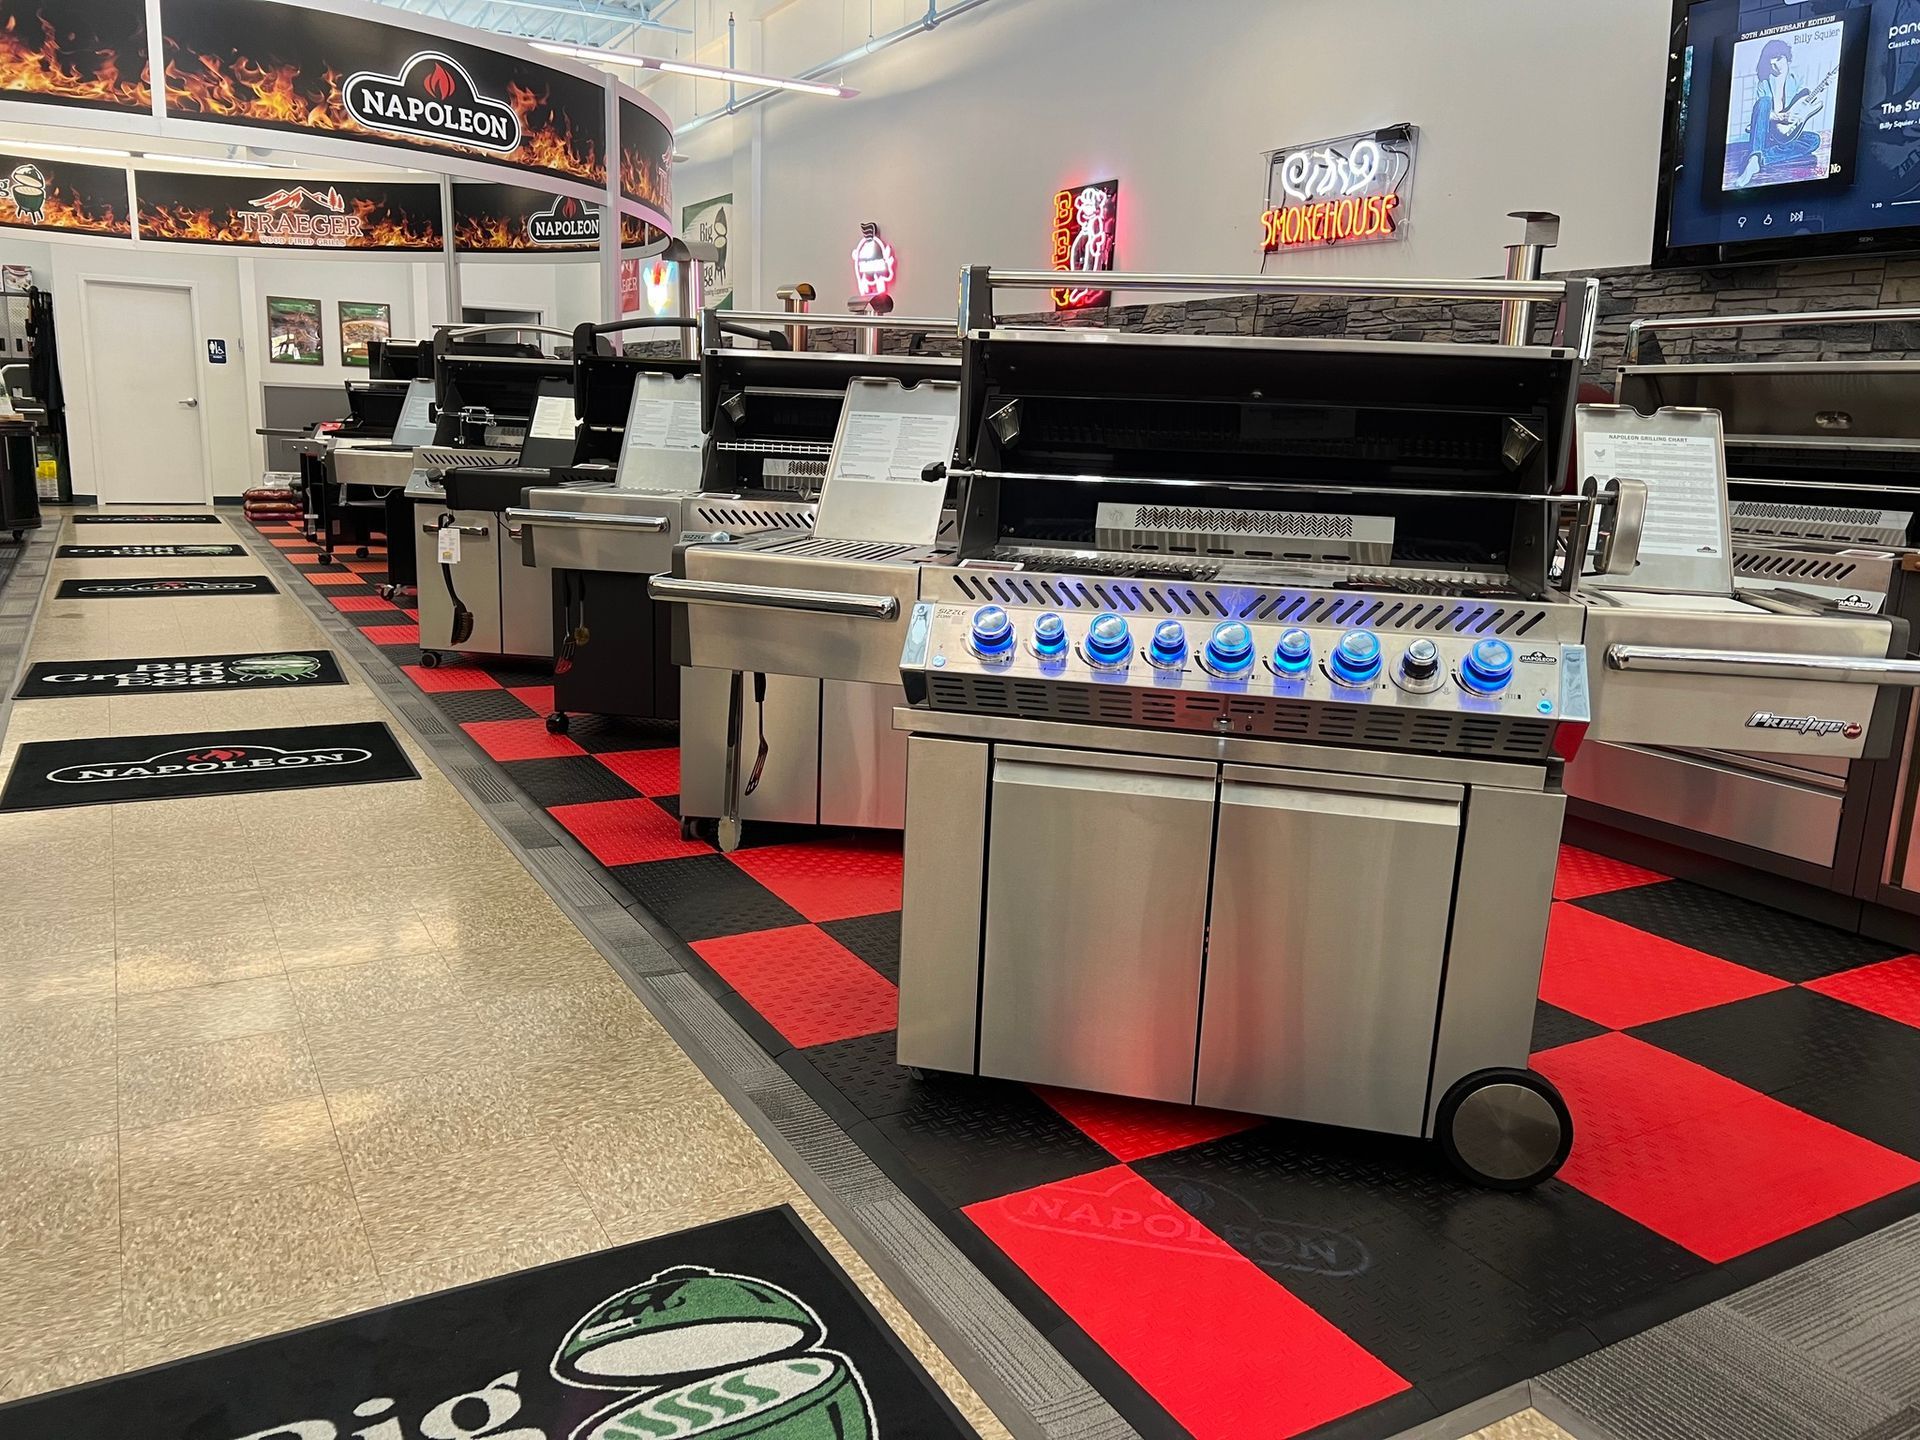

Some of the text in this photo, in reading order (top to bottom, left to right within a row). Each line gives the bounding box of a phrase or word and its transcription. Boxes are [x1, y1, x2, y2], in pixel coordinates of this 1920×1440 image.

[1759, 20, 1806, 36] ANNIVERSARY
[1808, 15, 1836, 27] EDITION
[1794, 28, 1841, 45] Billy Squier
[361, 88, 508, 140] NAPOLEON
[1881, 102, 1902, 115] The
[1893, 120, 1914, 129] Squier
[1830, 163, 1841, 174] No
[237, 211, 363, 237] TRAEGER
[535, 218, 600, 236] NAPOLEON
[1260, 193, 1396, 246] SMOKEHOUSE
[260, 235, 347, 247] WOOD FIRED GRILLS
[700, 222, 713, 243] Big
[704, 266, 713, 287] gg
[936, 608, 967, 616] SIZZLE
[135, 661, 224, 672] Big
[1521, 655, 1556, 663] NAPOLEON
[42, 669, 224, 683] Green
[1748, 712, 1844, 736] Prestige
[78, 753, 344, 779] NAPOLEON
[1022, 1194, 1340, 1266] NAPOLEON
